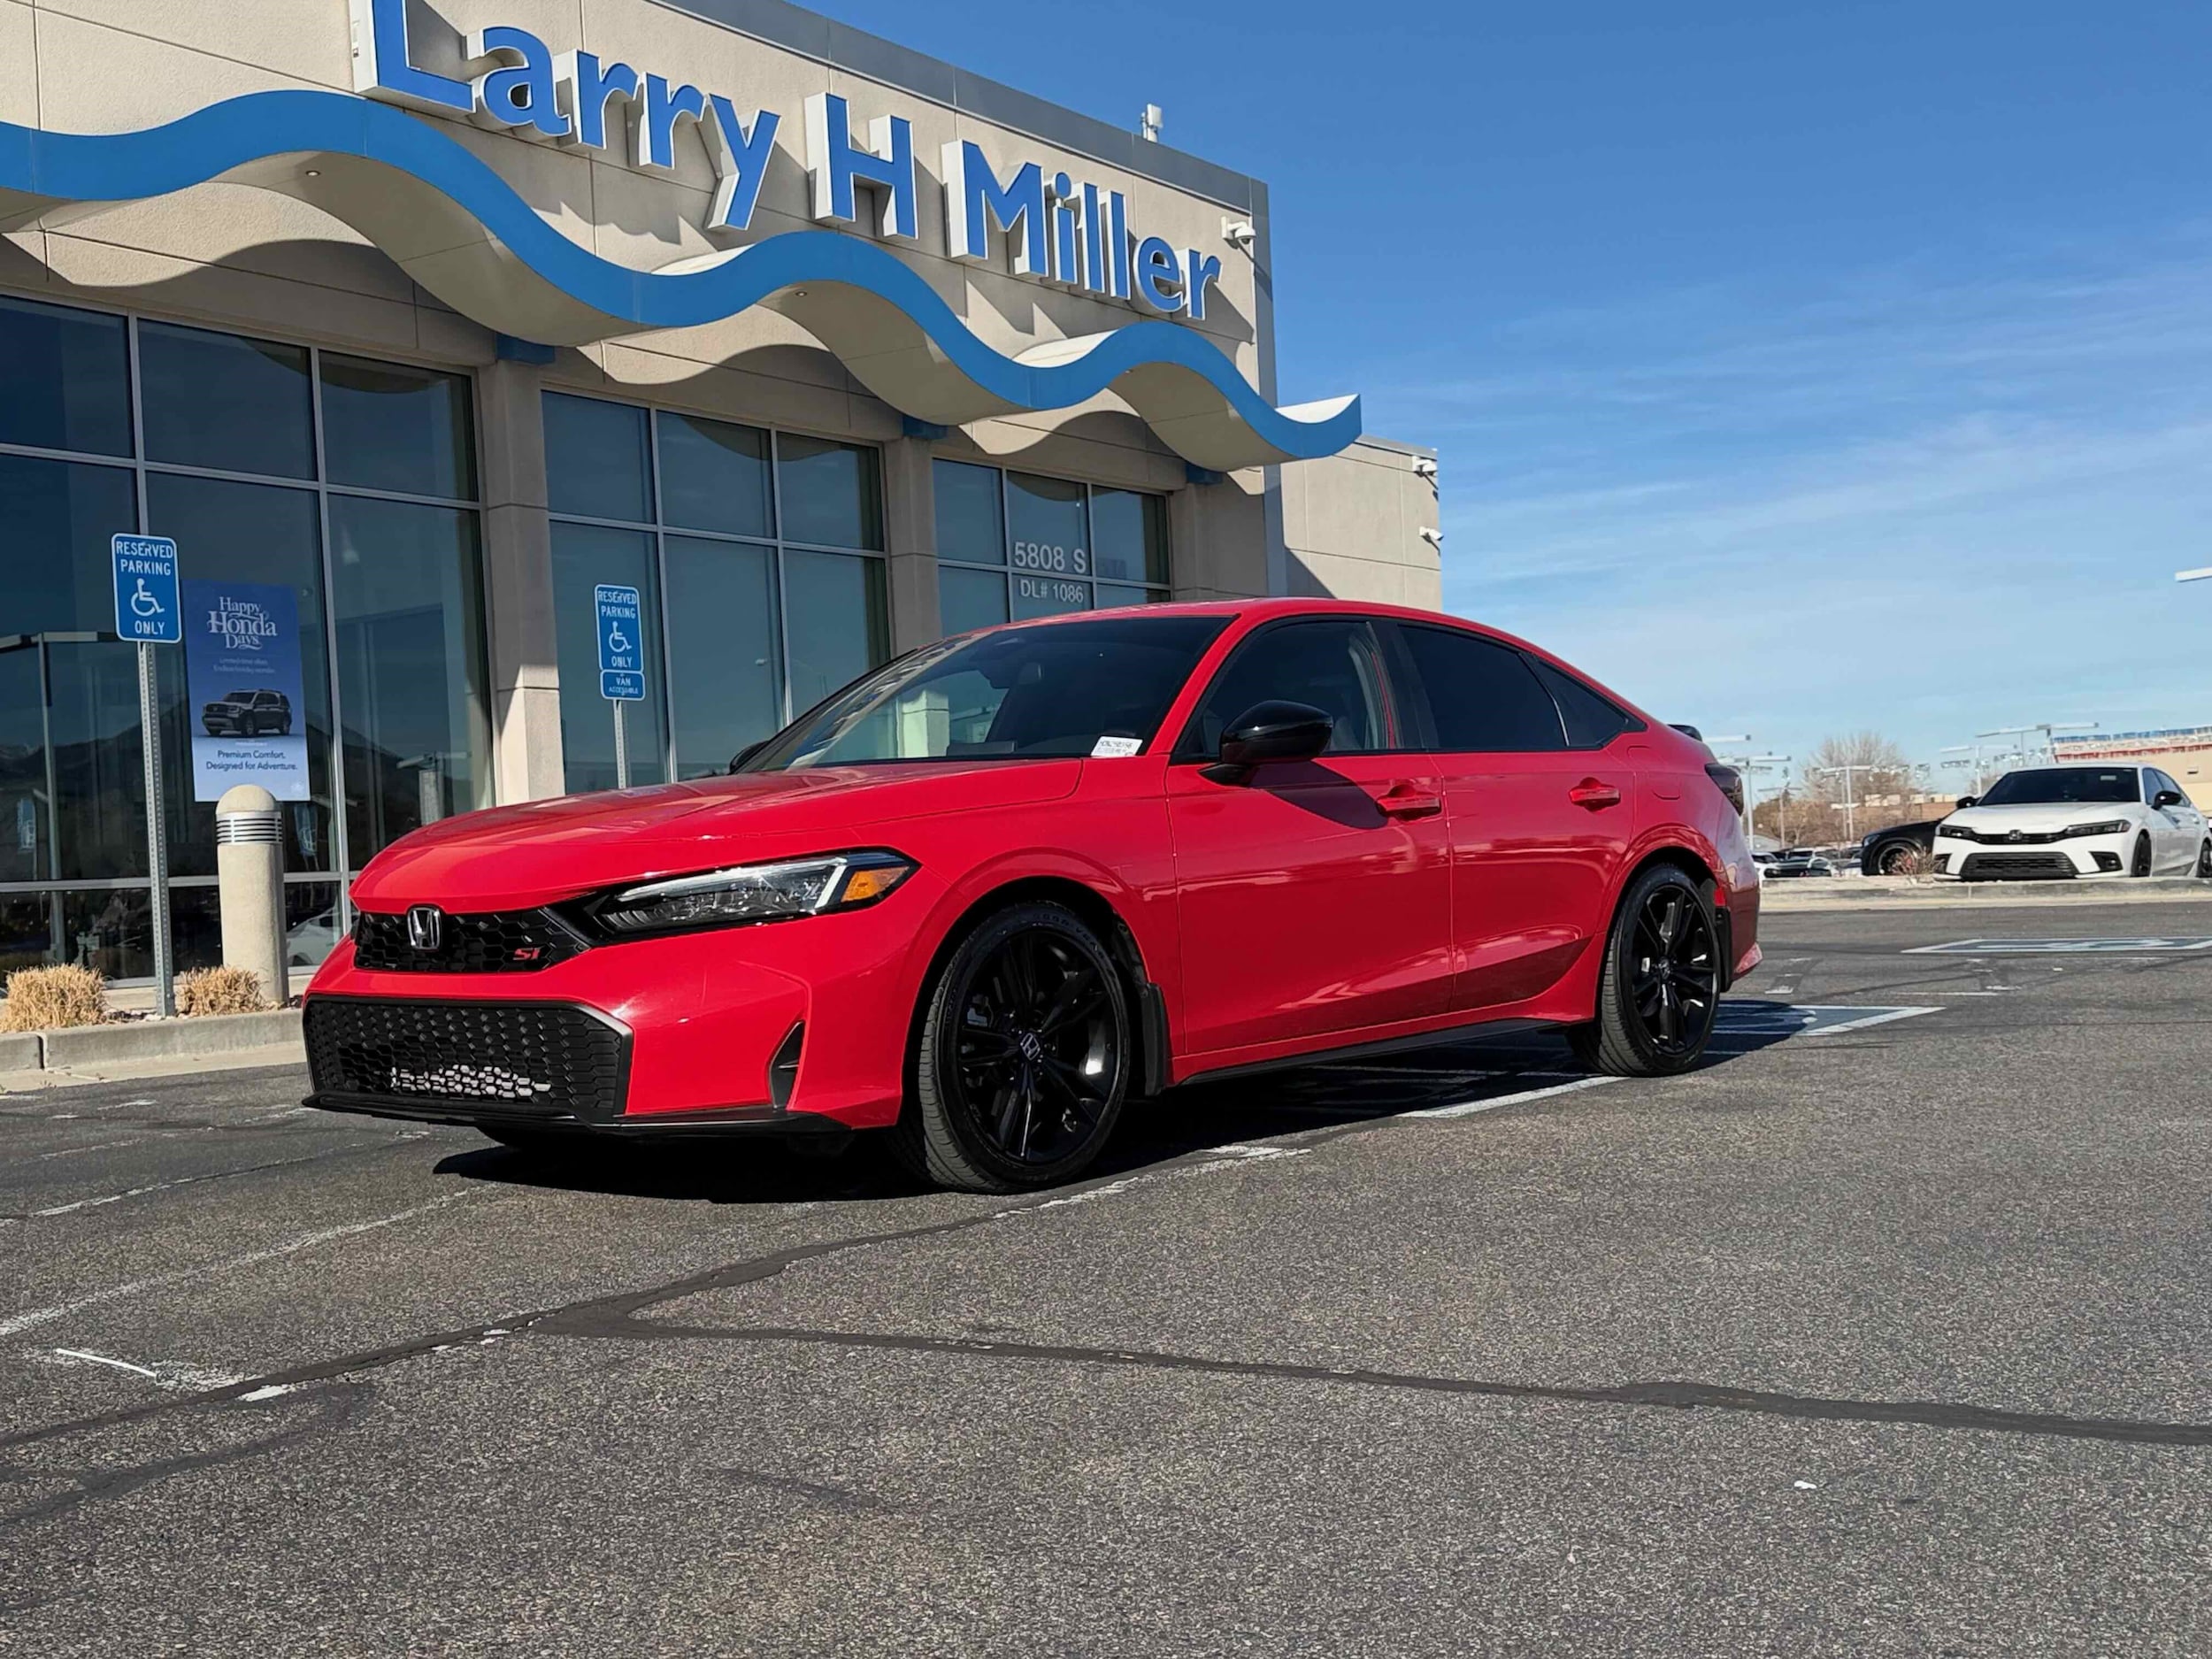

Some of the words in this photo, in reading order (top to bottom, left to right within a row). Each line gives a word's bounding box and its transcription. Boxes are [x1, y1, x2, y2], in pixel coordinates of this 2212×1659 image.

[370, 0, 781, 230] Larry
[823, 91, 919, 240] H
[959, 138, 1221, 321] Miller
[116, 541, 173, 558] RESERVED
[1014, 541, 1065, 572] 5808
[1073, 548, 1087, 574] S
[120, 558, 172, 576] PARKING
[597, 590, 637, 605] RESERVED
[1019, 579, 1048, 599] DL#
[1053, 582, 1084, 603] 1086
[219, 596, 262, 619] Happy
[601, 605, 636, 619] PARKING
[134, 620, 165, 635] ONLY
[207, 611, 278, 636] Honda
[611, 657, 633, 668] ONLY
[616, 677, 631, 687] VAN
